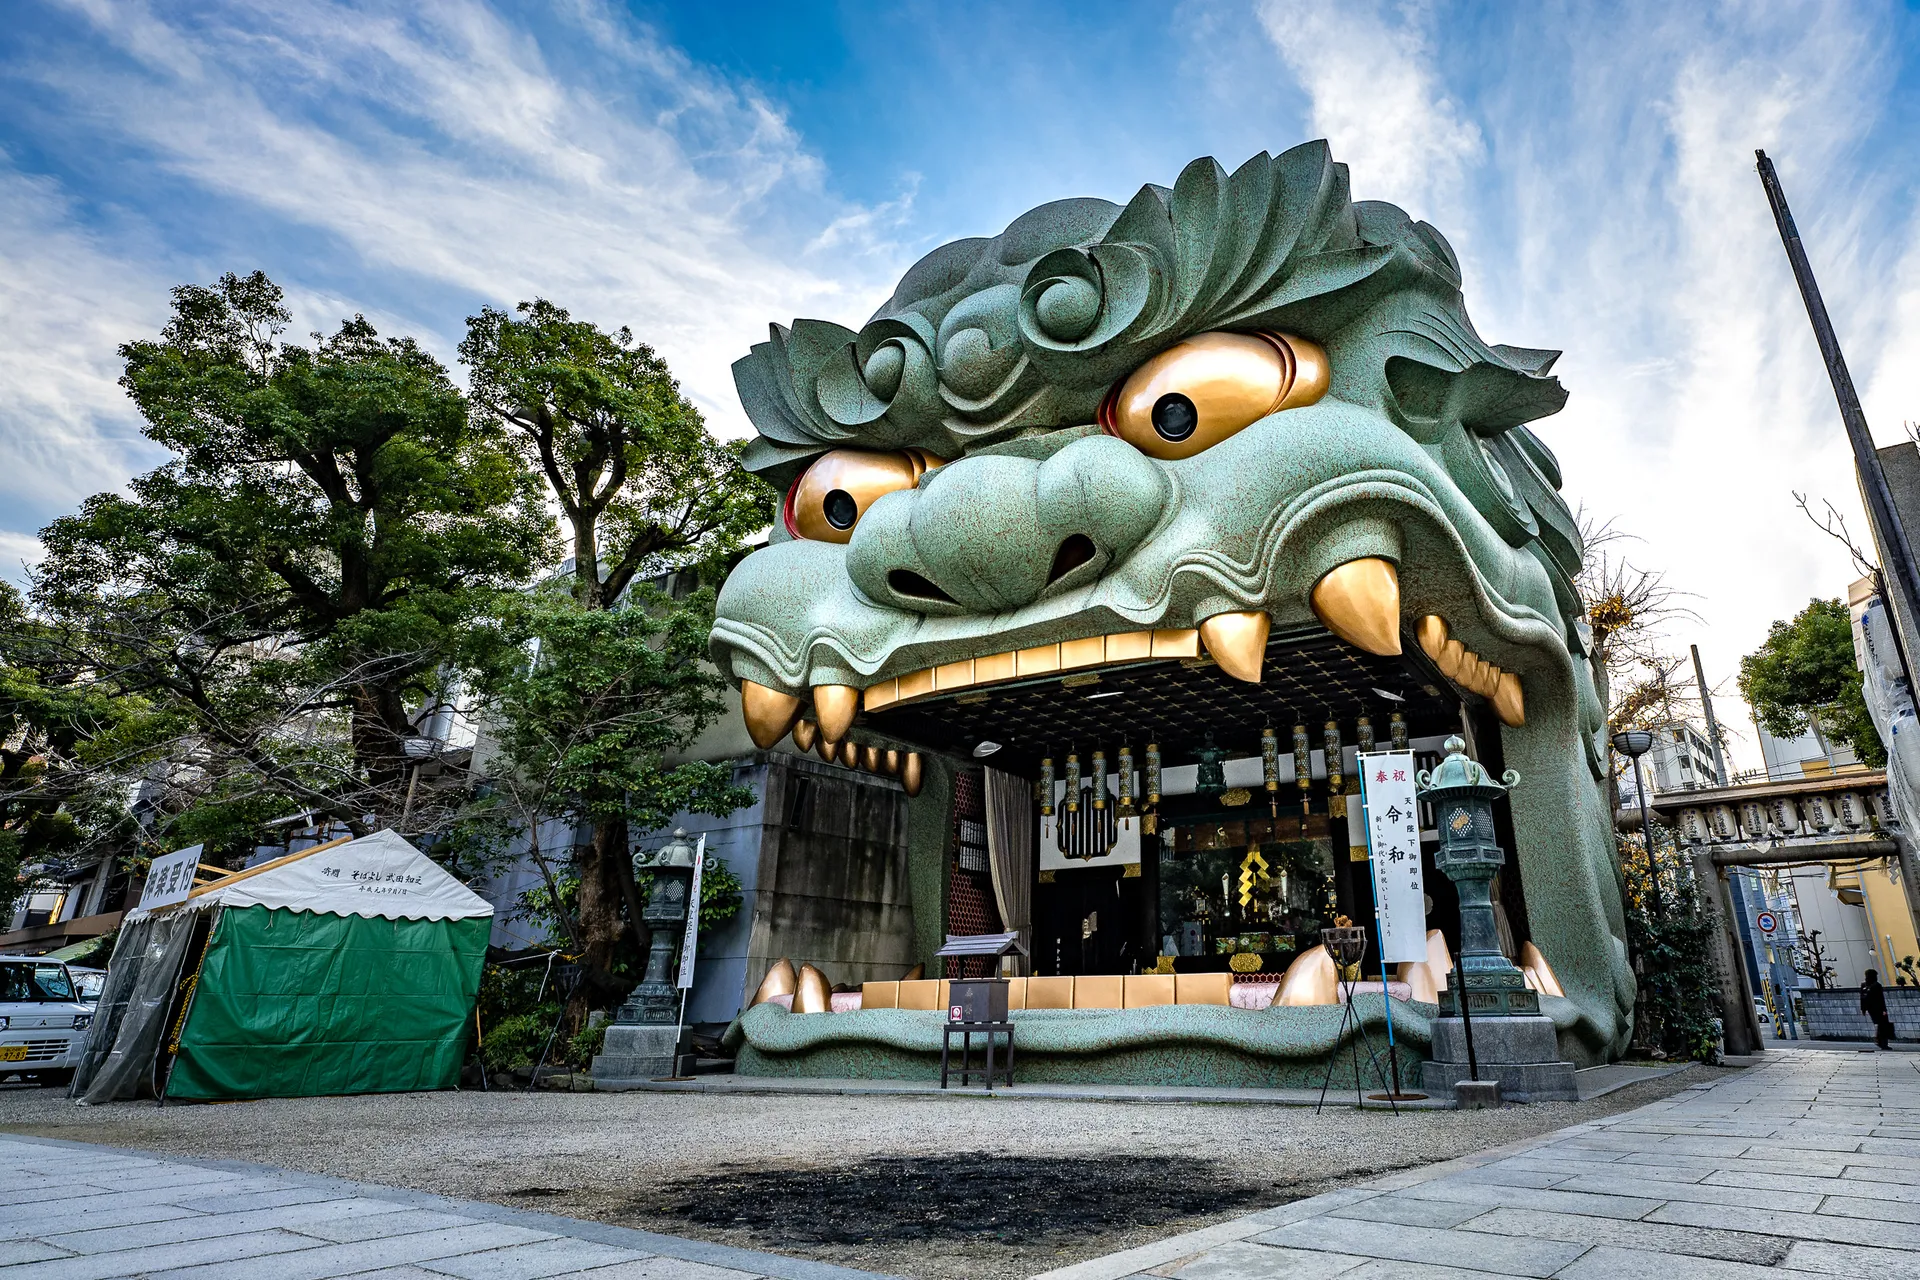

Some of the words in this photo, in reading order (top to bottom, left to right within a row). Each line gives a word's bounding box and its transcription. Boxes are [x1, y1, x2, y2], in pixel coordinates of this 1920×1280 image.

[1375, 768, 1407, 784] 奉祝
[1385, 804, 1405, 864] 令和
[1404, 796, 1420, 890] 天皇陛下御即位
[351, 870, 382, 881] そばよし
[1375, 815, 1391, 937] 新しい御代をお祝いしましょう
